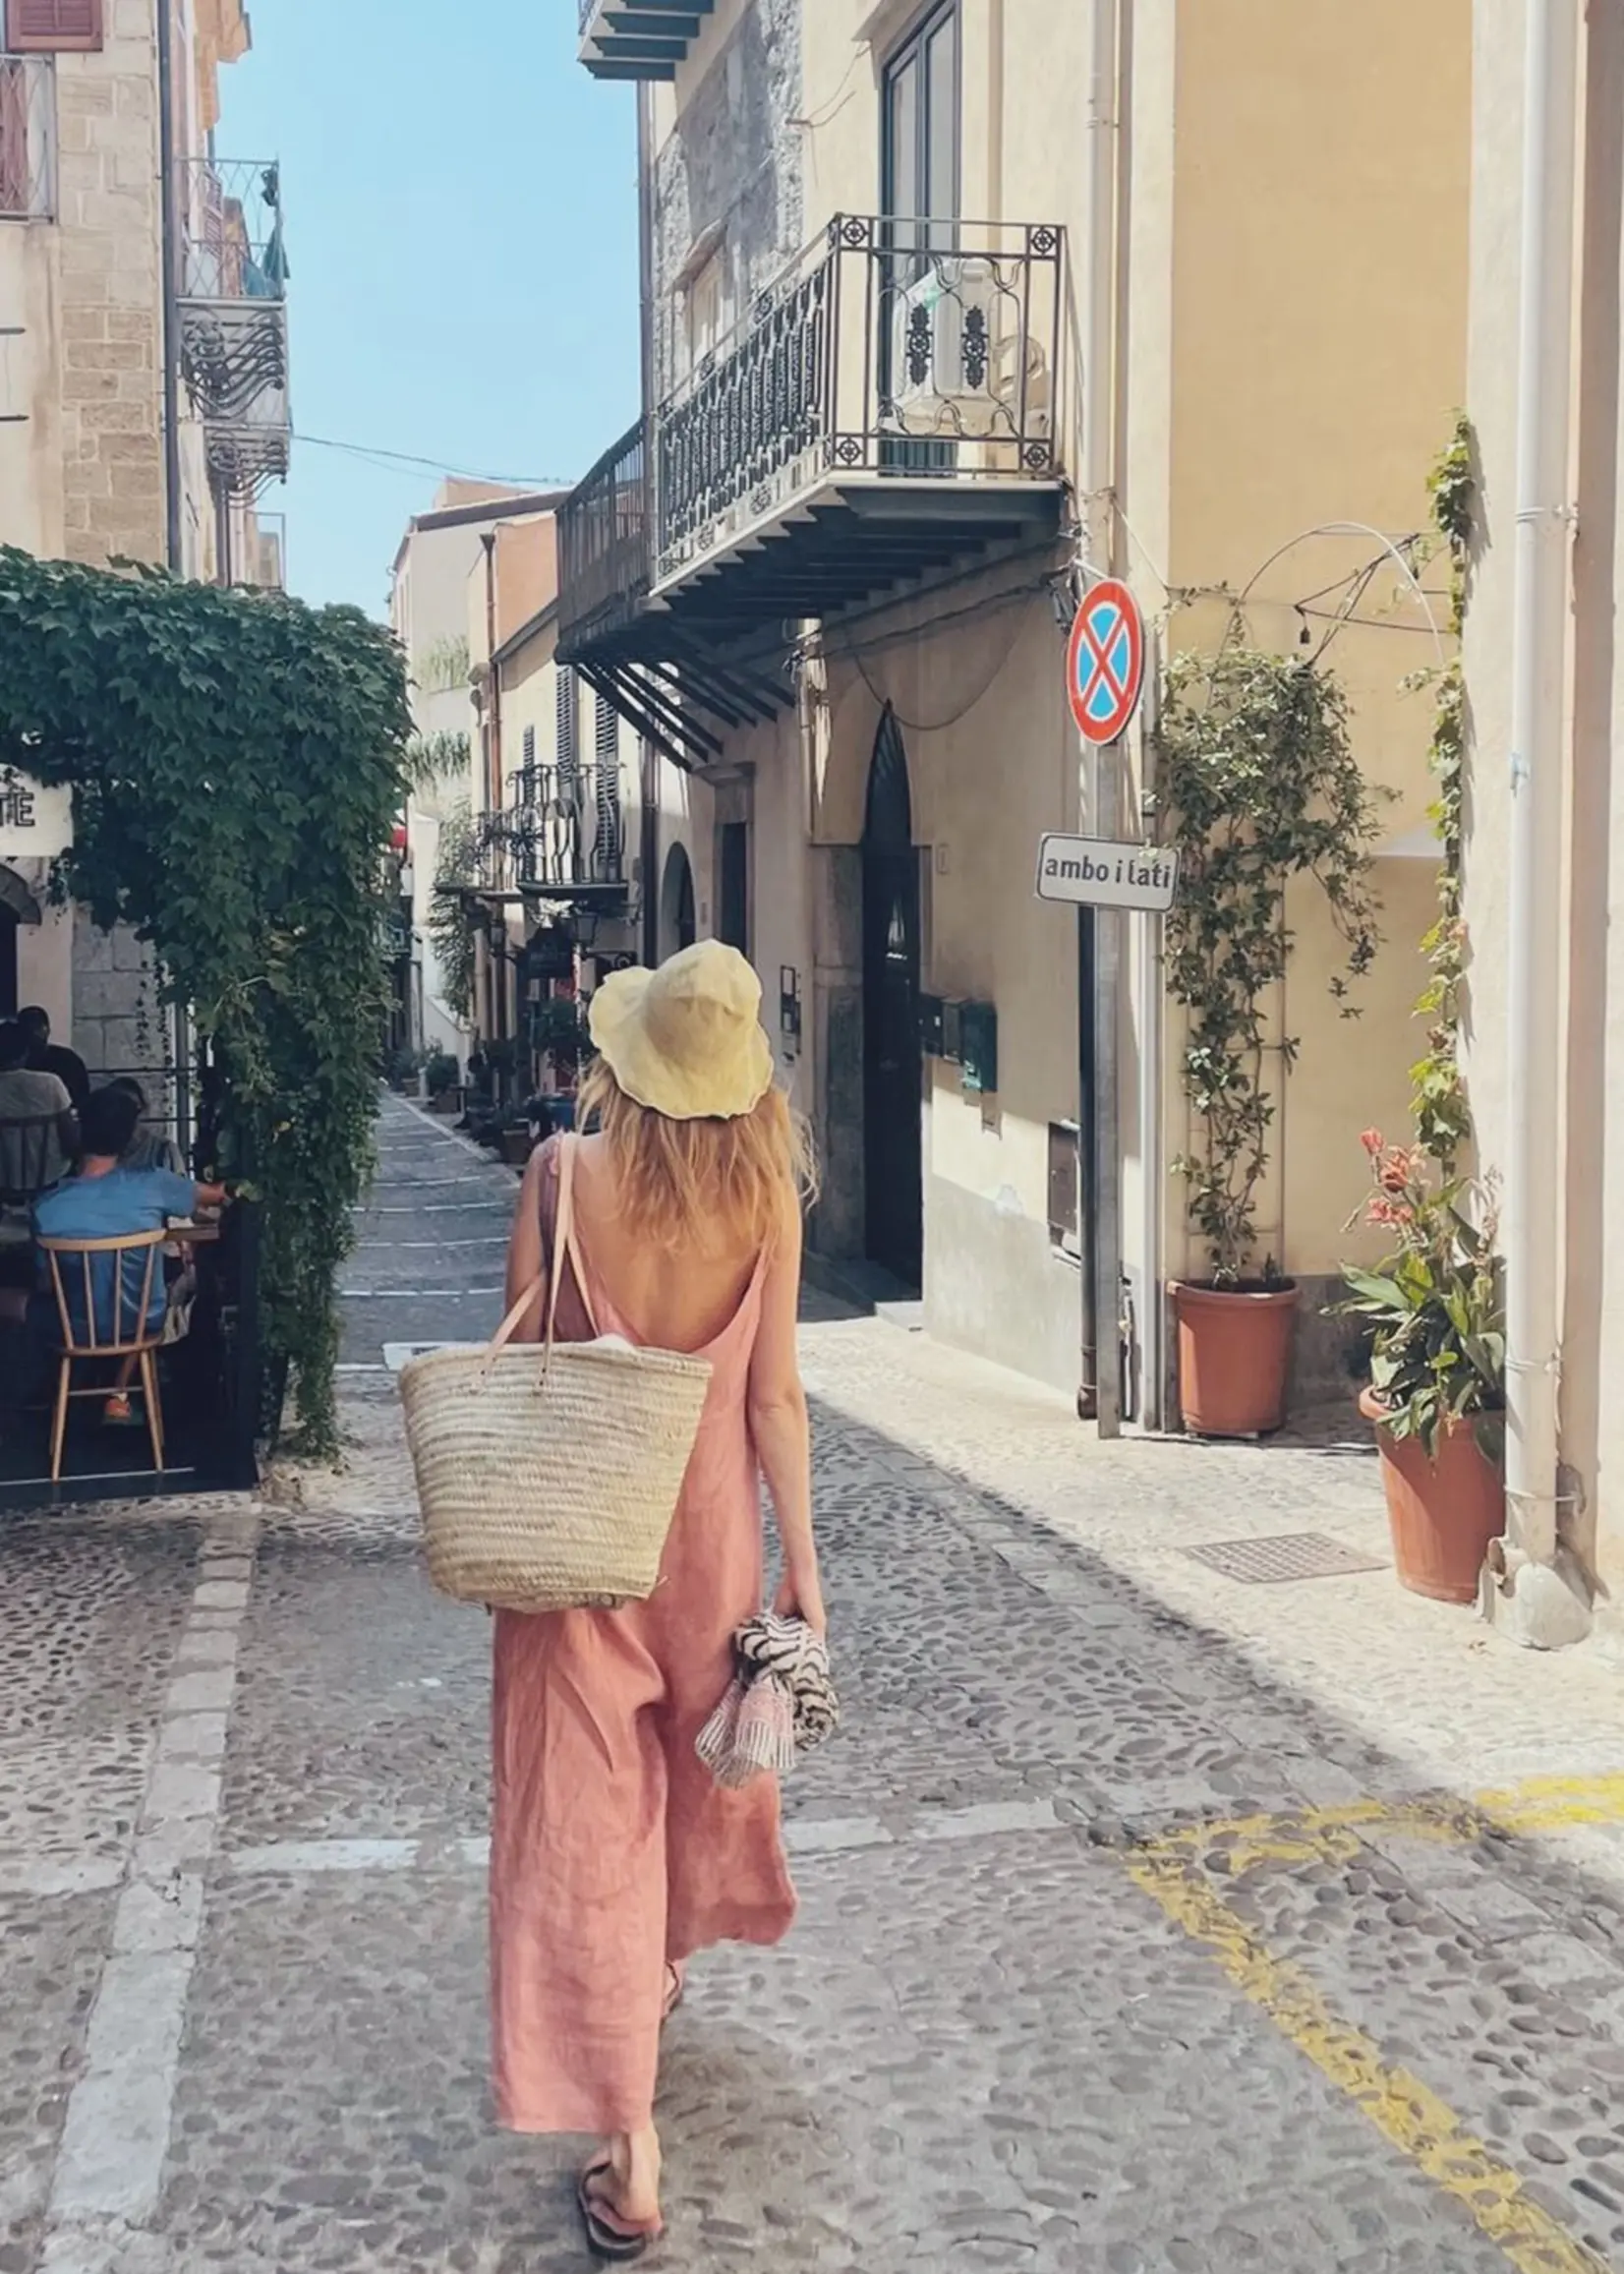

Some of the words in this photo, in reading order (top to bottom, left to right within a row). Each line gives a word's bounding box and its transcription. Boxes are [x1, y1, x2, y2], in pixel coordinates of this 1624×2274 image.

[1045, 855, 1110, 882] ambo
[1115, 859, 1124, 884] i
[1128, 859, 1171, 889] lati
